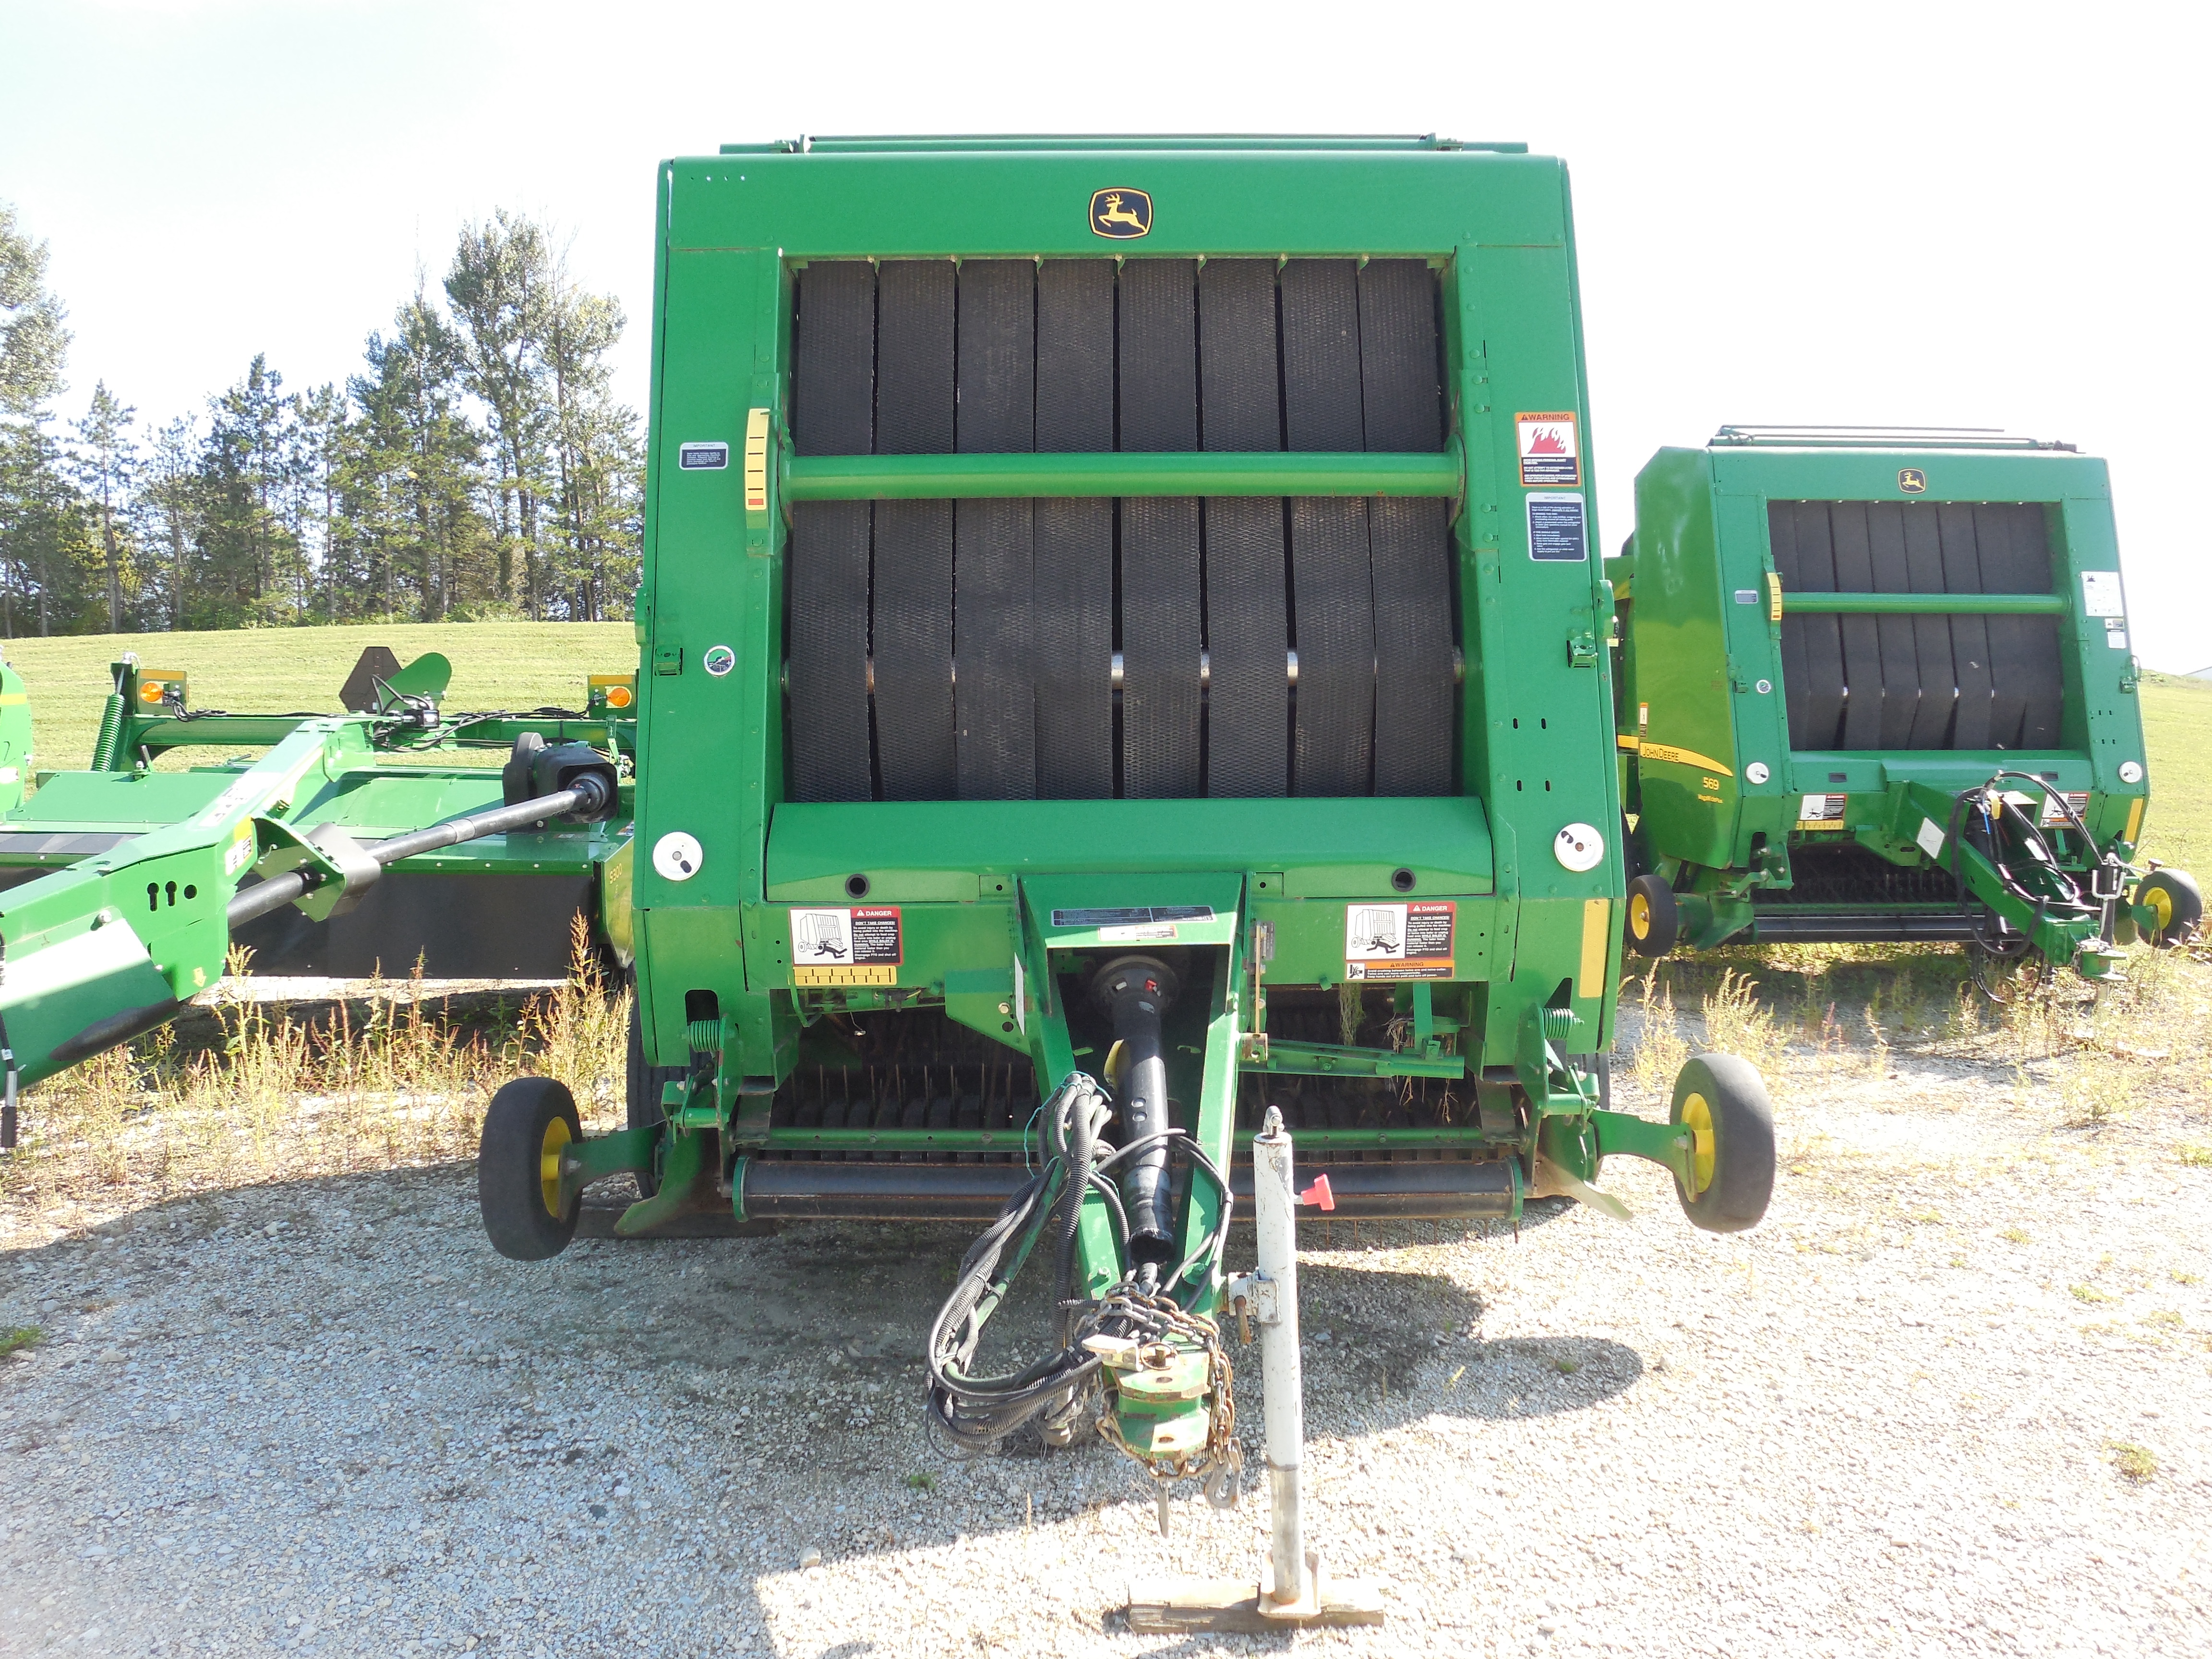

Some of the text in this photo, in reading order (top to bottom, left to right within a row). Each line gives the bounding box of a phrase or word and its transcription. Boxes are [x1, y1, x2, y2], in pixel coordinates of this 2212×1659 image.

[1643, 746, 1679, 760] JOHN DEERE
[1703, 777, 1719, 790] 569
